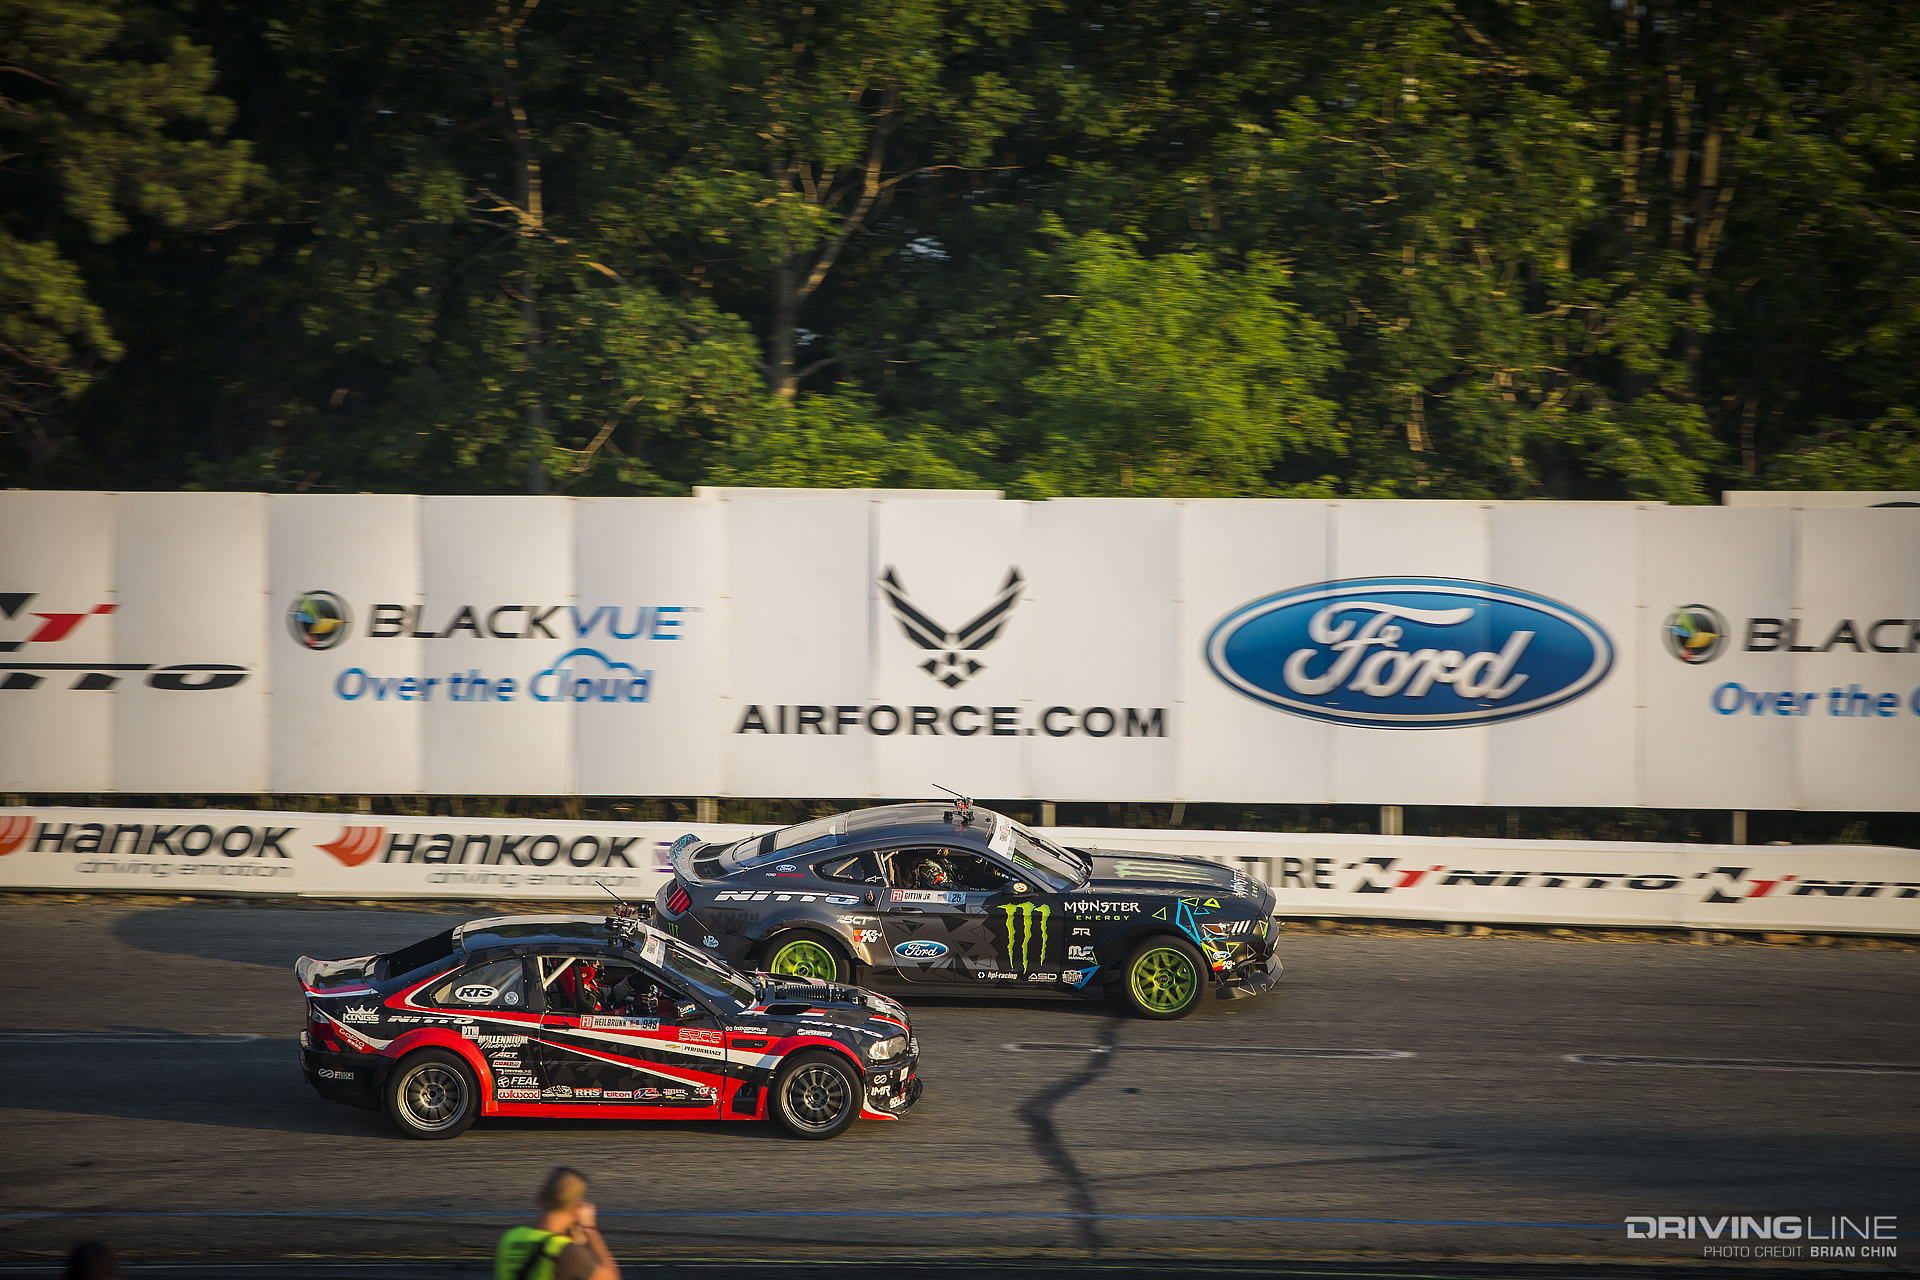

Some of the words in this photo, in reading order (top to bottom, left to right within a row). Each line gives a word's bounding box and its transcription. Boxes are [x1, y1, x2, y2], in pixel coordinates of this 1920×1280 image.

[365, 604, 684, 640] BLACKVUE
[1282, 600, 1537, 699] Ford
[334, 667, 441, 702] Over
[451, 669, 518, 702] the
[529, 660, 655, 703] Cloud
[1710, 682, 1820, 717] Over
[1826, 684, 1902, 718] the
[733, 704, 1170, 738] AIRFORCE.COM
[1438, 869, 1685, 890] NITTO
[714, 891, 860, 906] NITTO
[904, 892, 922, 900] GITTIN
[951, 893, 962, 903] 25
[1064, 900, 1141, 914] MONSTER
[904, 943, 938, 957] Ford
[459, 987, 494, 998] RTS
[343, 1012, 380, 1023] KINGS
[387, 1015, 475, 1024] NITTO
[594, 1017, 627, 1027] HEILBRUNN
[684, 1045, 722, 1056] PERFORMANCE
[511, 1076, 540, 1085] FEAL
[498, 1089, 540, 1099] wilwood
[576, 1088, 600, 1096] RHS
